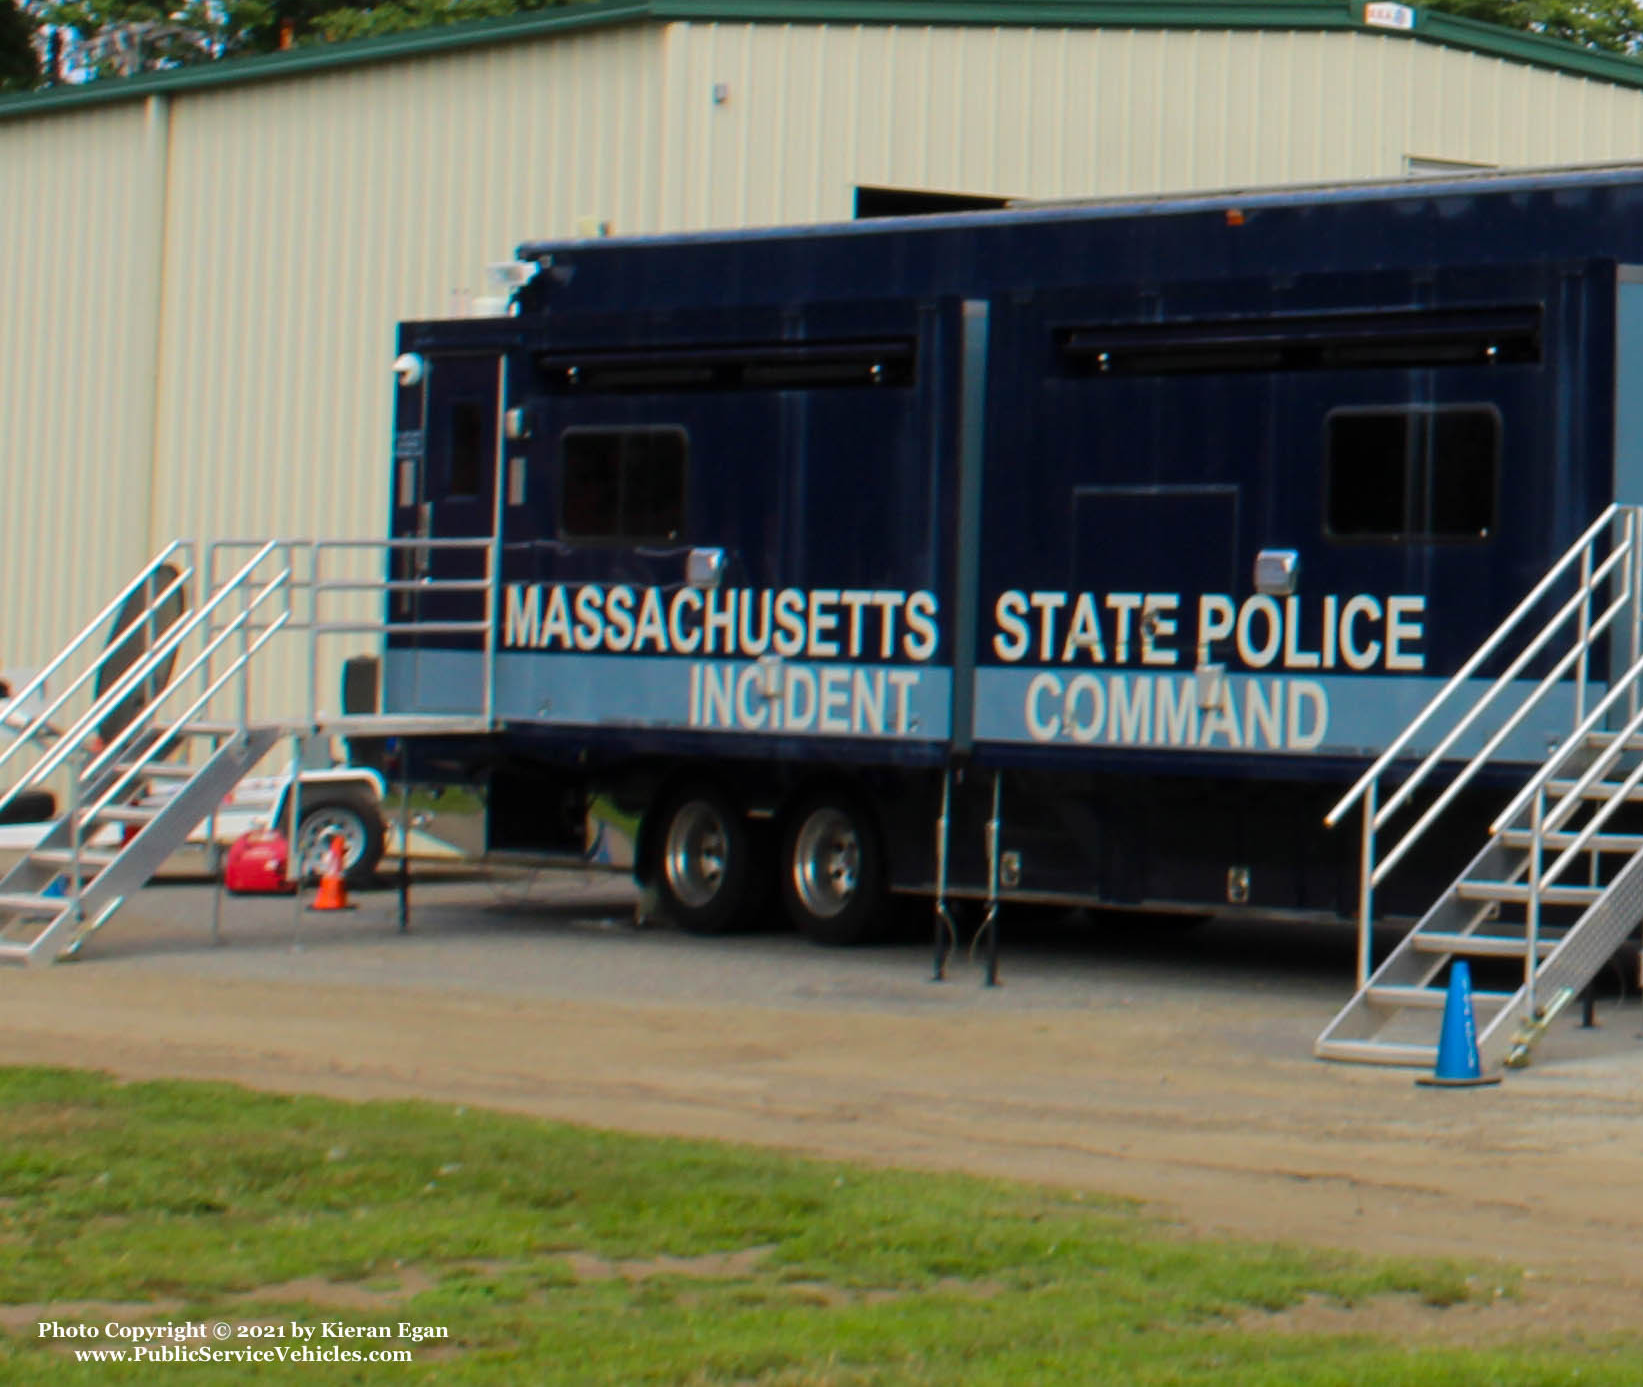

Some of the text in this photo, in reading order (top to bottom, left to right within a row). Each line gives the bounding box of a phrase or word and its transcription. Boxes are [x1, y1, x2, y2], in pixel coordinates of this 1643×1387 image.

[504, 584, 1426, 671] MASSACHUSETTS STATE POLICE
[688, 661, 1329, 750] INCIDENT COMMAND
